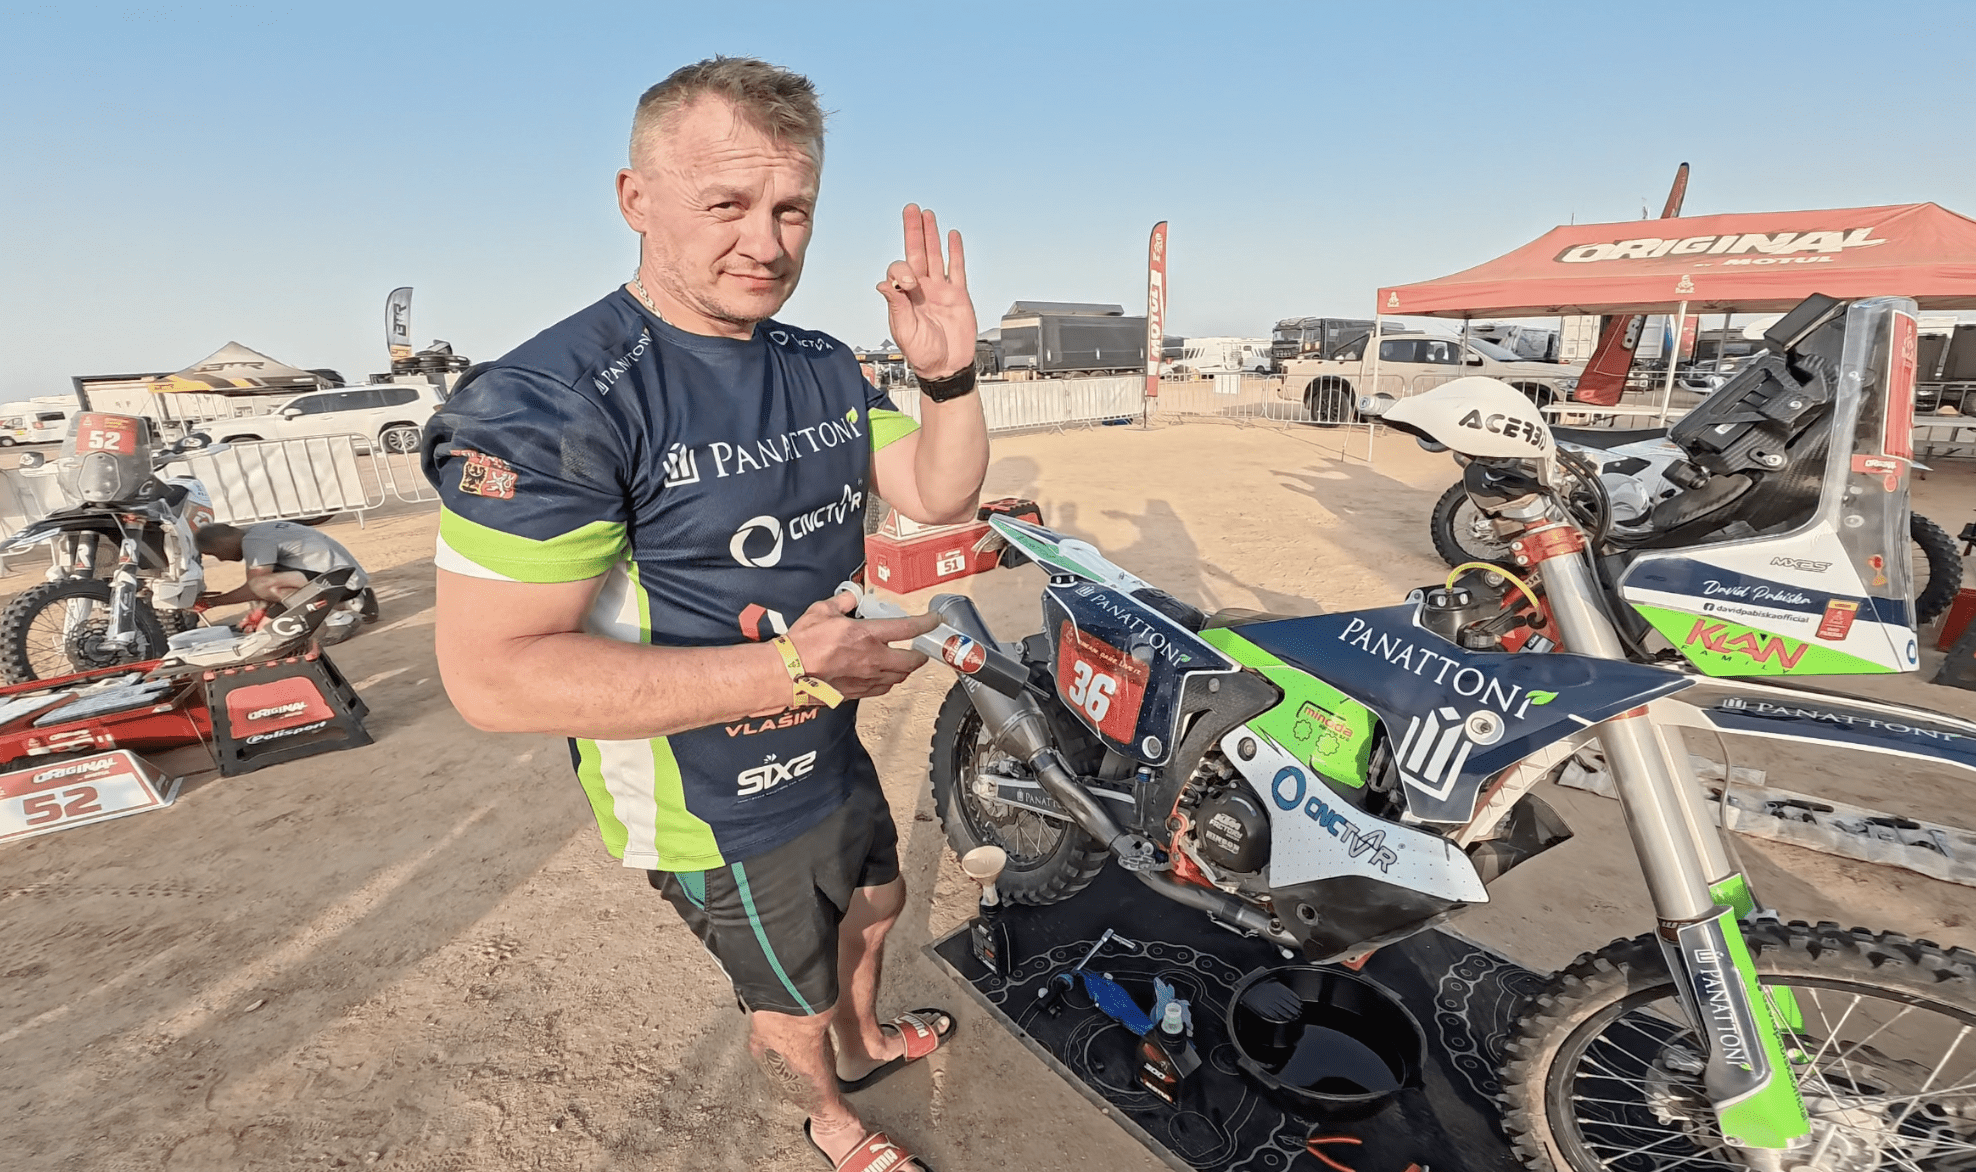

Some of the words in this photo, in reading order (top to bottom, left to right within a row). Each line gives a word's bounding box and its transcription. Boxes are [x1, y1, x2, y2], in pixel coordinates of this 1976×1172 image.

[1561, 226, 1889, 263] ORIGINAL
[1721, 256, 1834, 266] MOTUL
[1150, 288, 1161, 358] MOTUL
[88, 430, 121, 450] 52
[708, 414, 862, 478] PANATTONI
[944, 558, 959, 572] 51
[1703, 580, 1751, 597] David
[1090, 594, 1180, 667] PANATTONI
[1716, 606, 1809, 623] davidpabiskaofficial
[1338, 617, 1531, 720] PANATTONI
[1069, 660, 1117, 722] 36
[252, 721, 327, 742] Polisport
[725, 708, 819, 737] VLAŠIM
[1757, 702, 1957, 742] PANATTONI
[33, 757, 118, 783] ORIGINAL
[23, 786, 102, 826] 52
